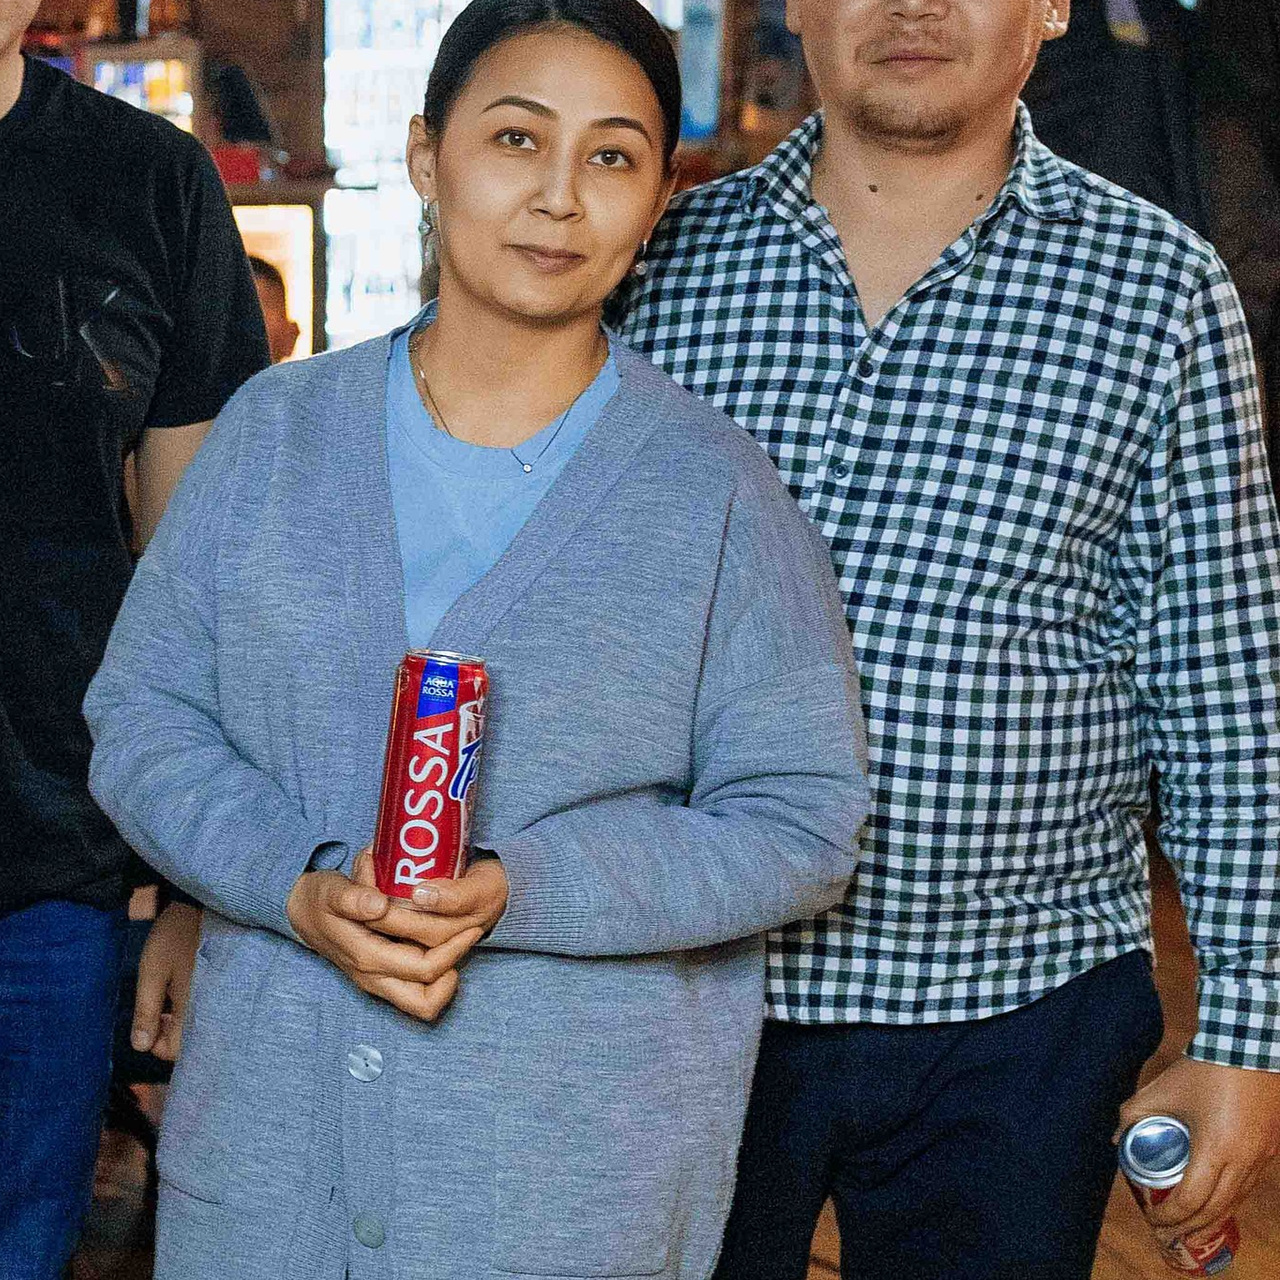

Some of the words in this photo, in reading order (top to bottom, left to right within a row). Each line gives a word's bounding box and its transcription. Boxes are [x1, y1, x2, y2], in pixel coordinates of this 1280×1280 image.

[424, 676, 455, 689] AQUA
[422, 686, 455, 698] ROSSA
[394, 722, 454, 886] ROSSA
